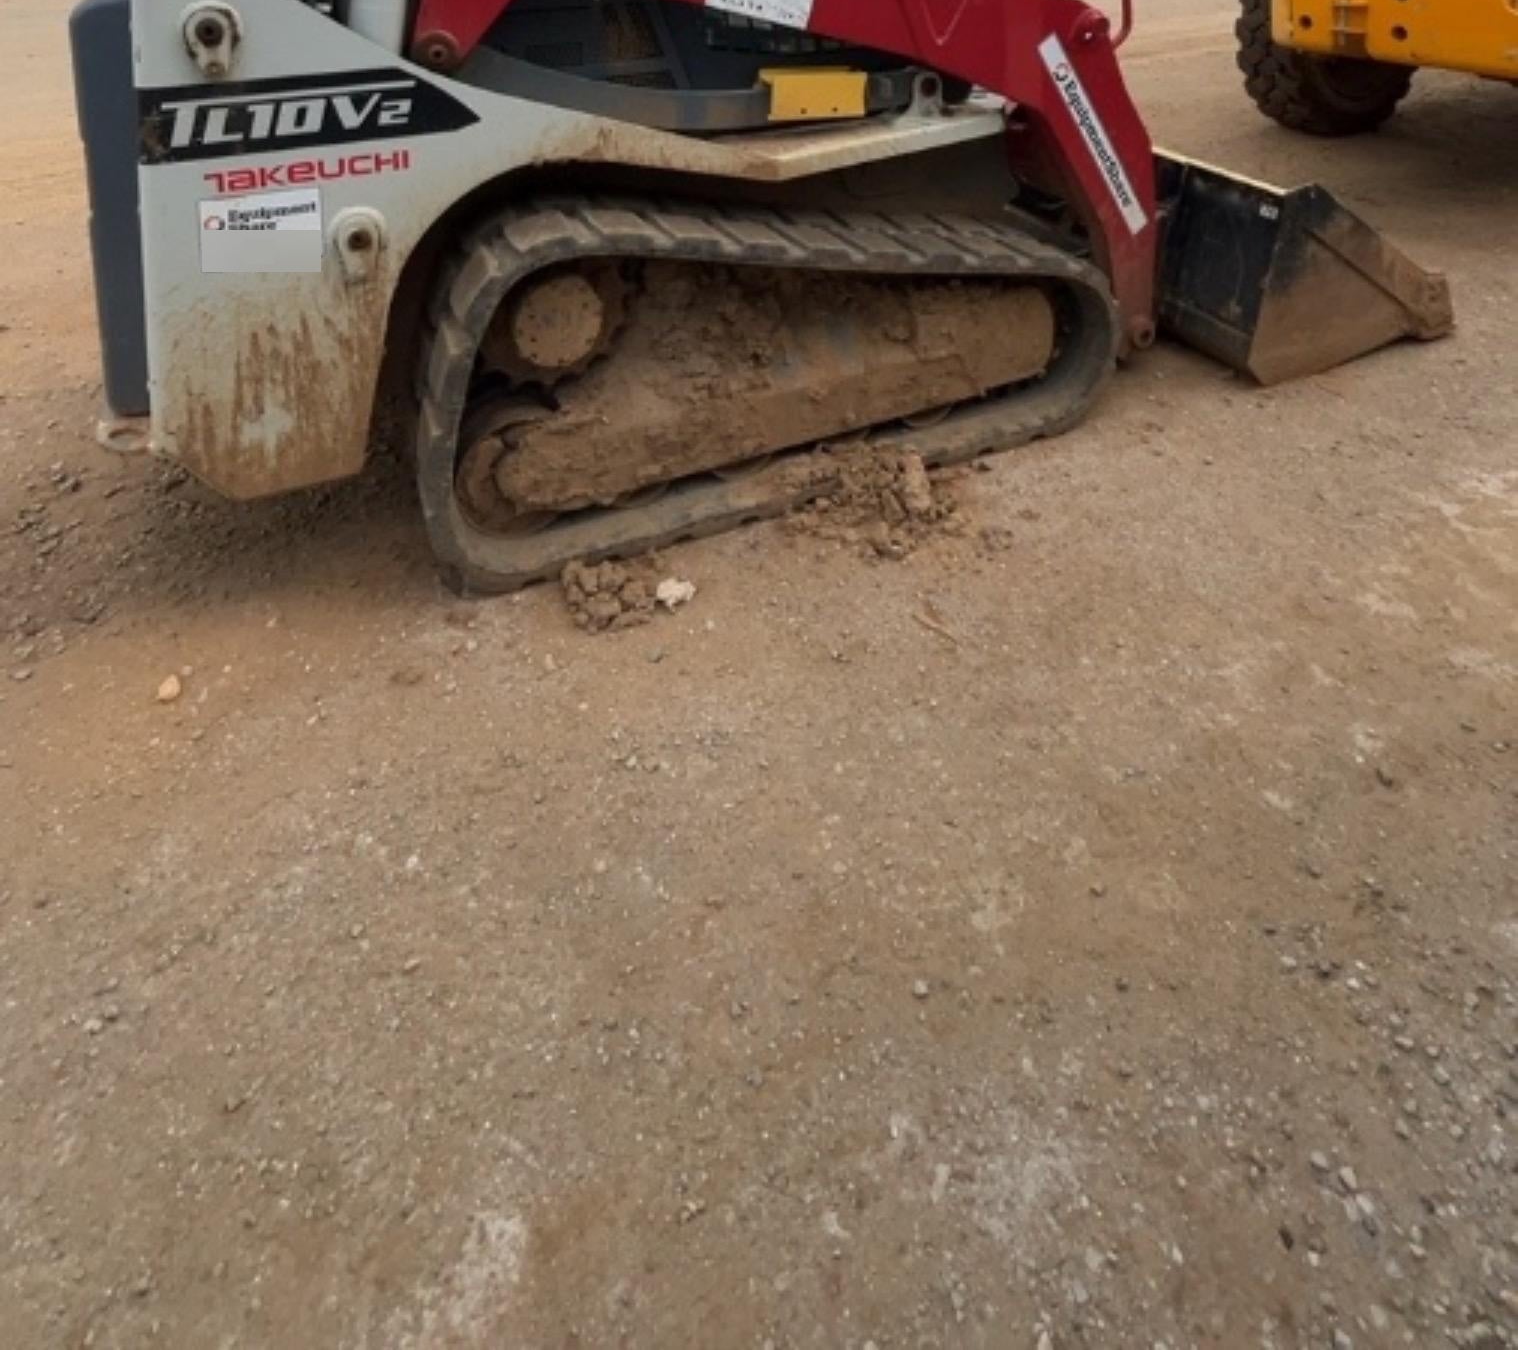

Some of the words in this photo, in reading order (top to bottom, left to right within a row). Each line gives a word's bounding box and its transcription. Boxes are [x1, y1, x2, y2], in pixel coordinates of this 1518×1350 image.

[161, 80, 416, 148] TL10V2
[204, 149, 410, 194] TAKEUCHI
[227, 201, 316, 222] Equipment
